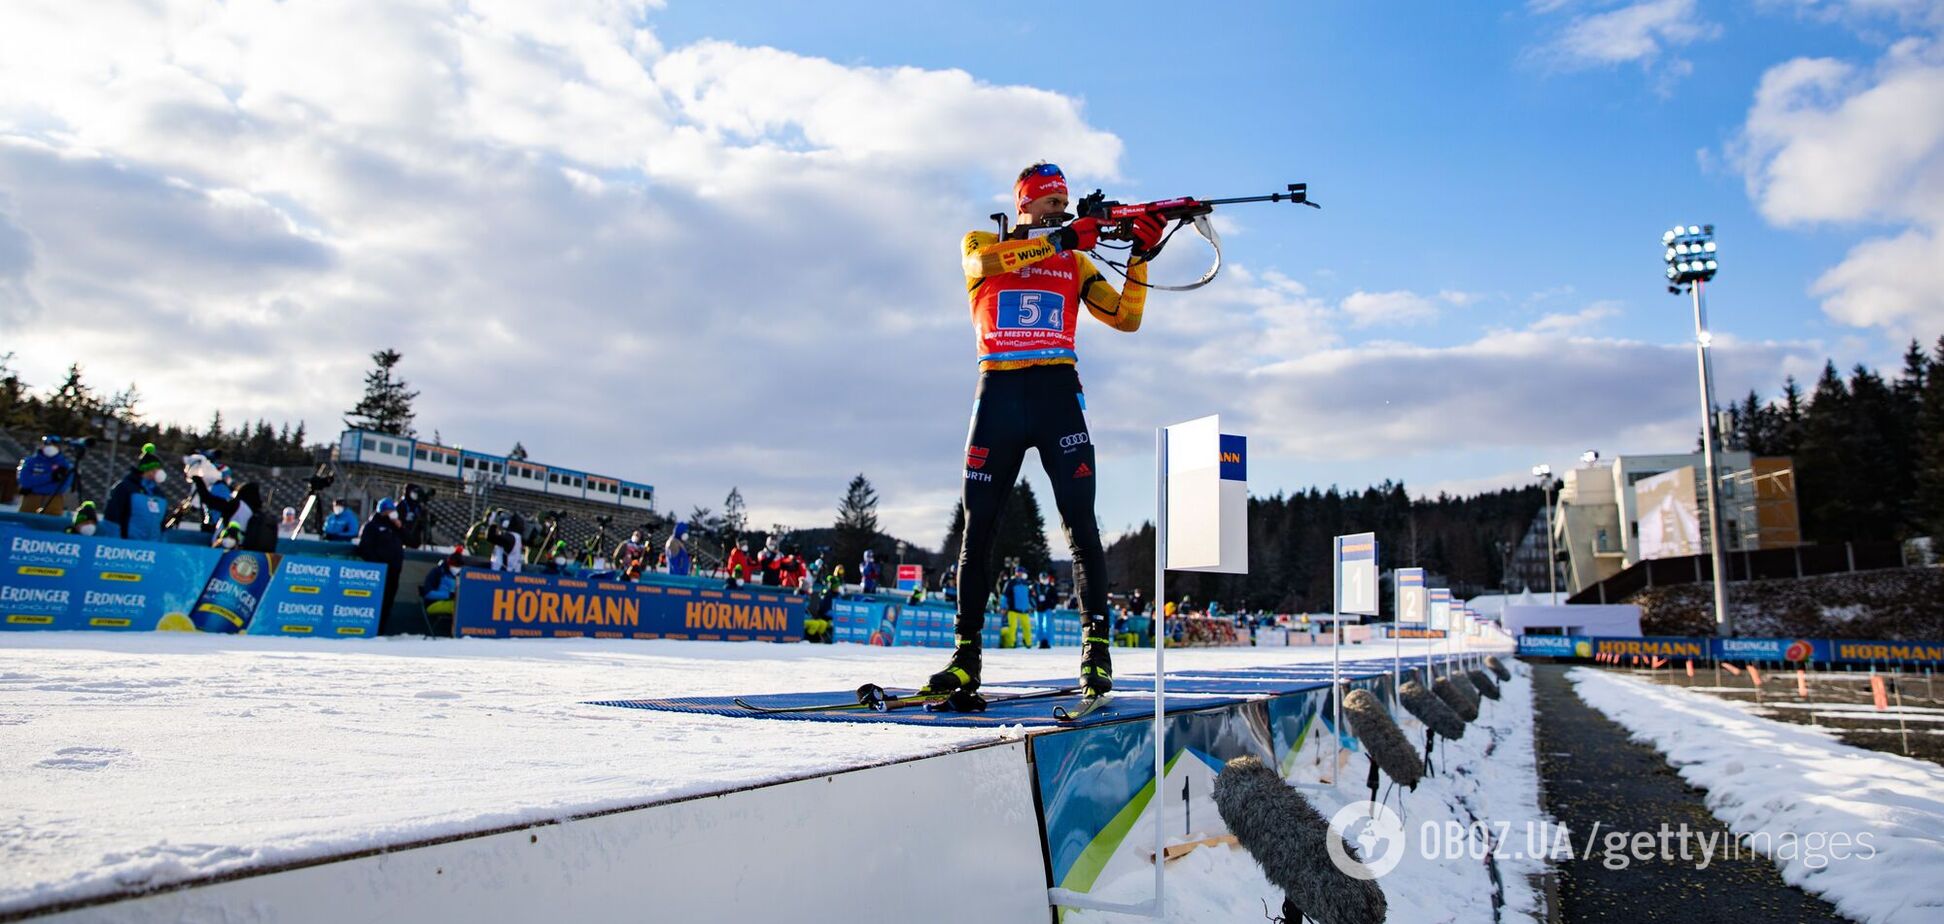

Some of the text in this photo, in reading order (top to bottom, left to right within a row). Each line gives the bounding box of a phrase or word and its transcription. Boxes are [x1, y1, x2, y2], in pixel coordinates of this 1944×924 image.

[1019, 293, 1041, 327] 5
[1049, 308, 1061, 328] 4
[1004, 330, 1032, 338] MESTO
[12, 537, 81, 558] ERDINGER
[95, 545, 156, 563] ERDINGER
[285, 561, 331, 577] ERDINGER
[339, 566, 381, 582] ERDINGER
[1, 586, 70, 604] ERDINGER
[84, 591, 147, 608] ERDINGER
[206, 578, 257, 612] ERDINGER
[277, 601, 324, 616] ERDINGER
[332, 604, 375, 619] ERDINGER
[492, 587, 640, 626] HÖRMANN
[1406, 591, 1417, 618] 2
[685, 600, 788, 631] HÖRMANN
